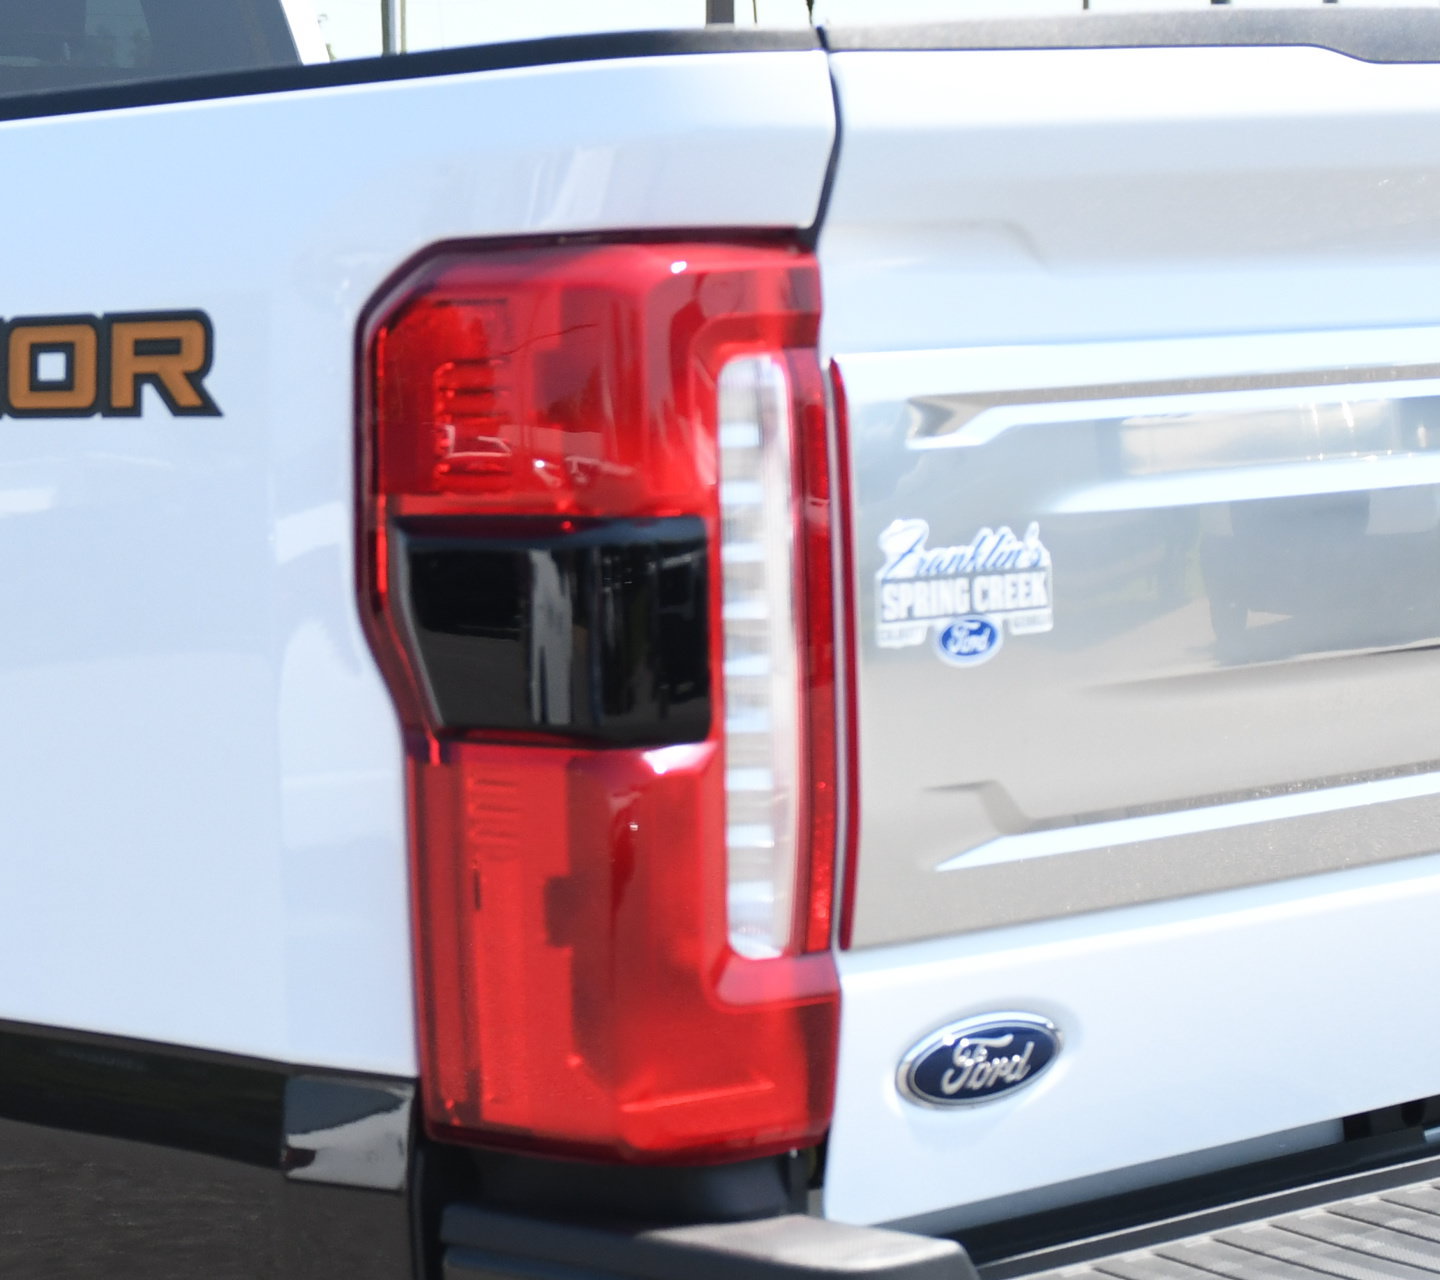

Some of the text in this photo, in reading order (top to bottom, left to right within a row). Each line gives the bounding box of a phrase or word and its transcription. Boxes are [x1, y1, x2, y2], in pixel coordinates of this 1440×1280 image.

[882, 571, 1048, 620] SPRING CREEK
[941, 1033, 1035, 1095] Ford
